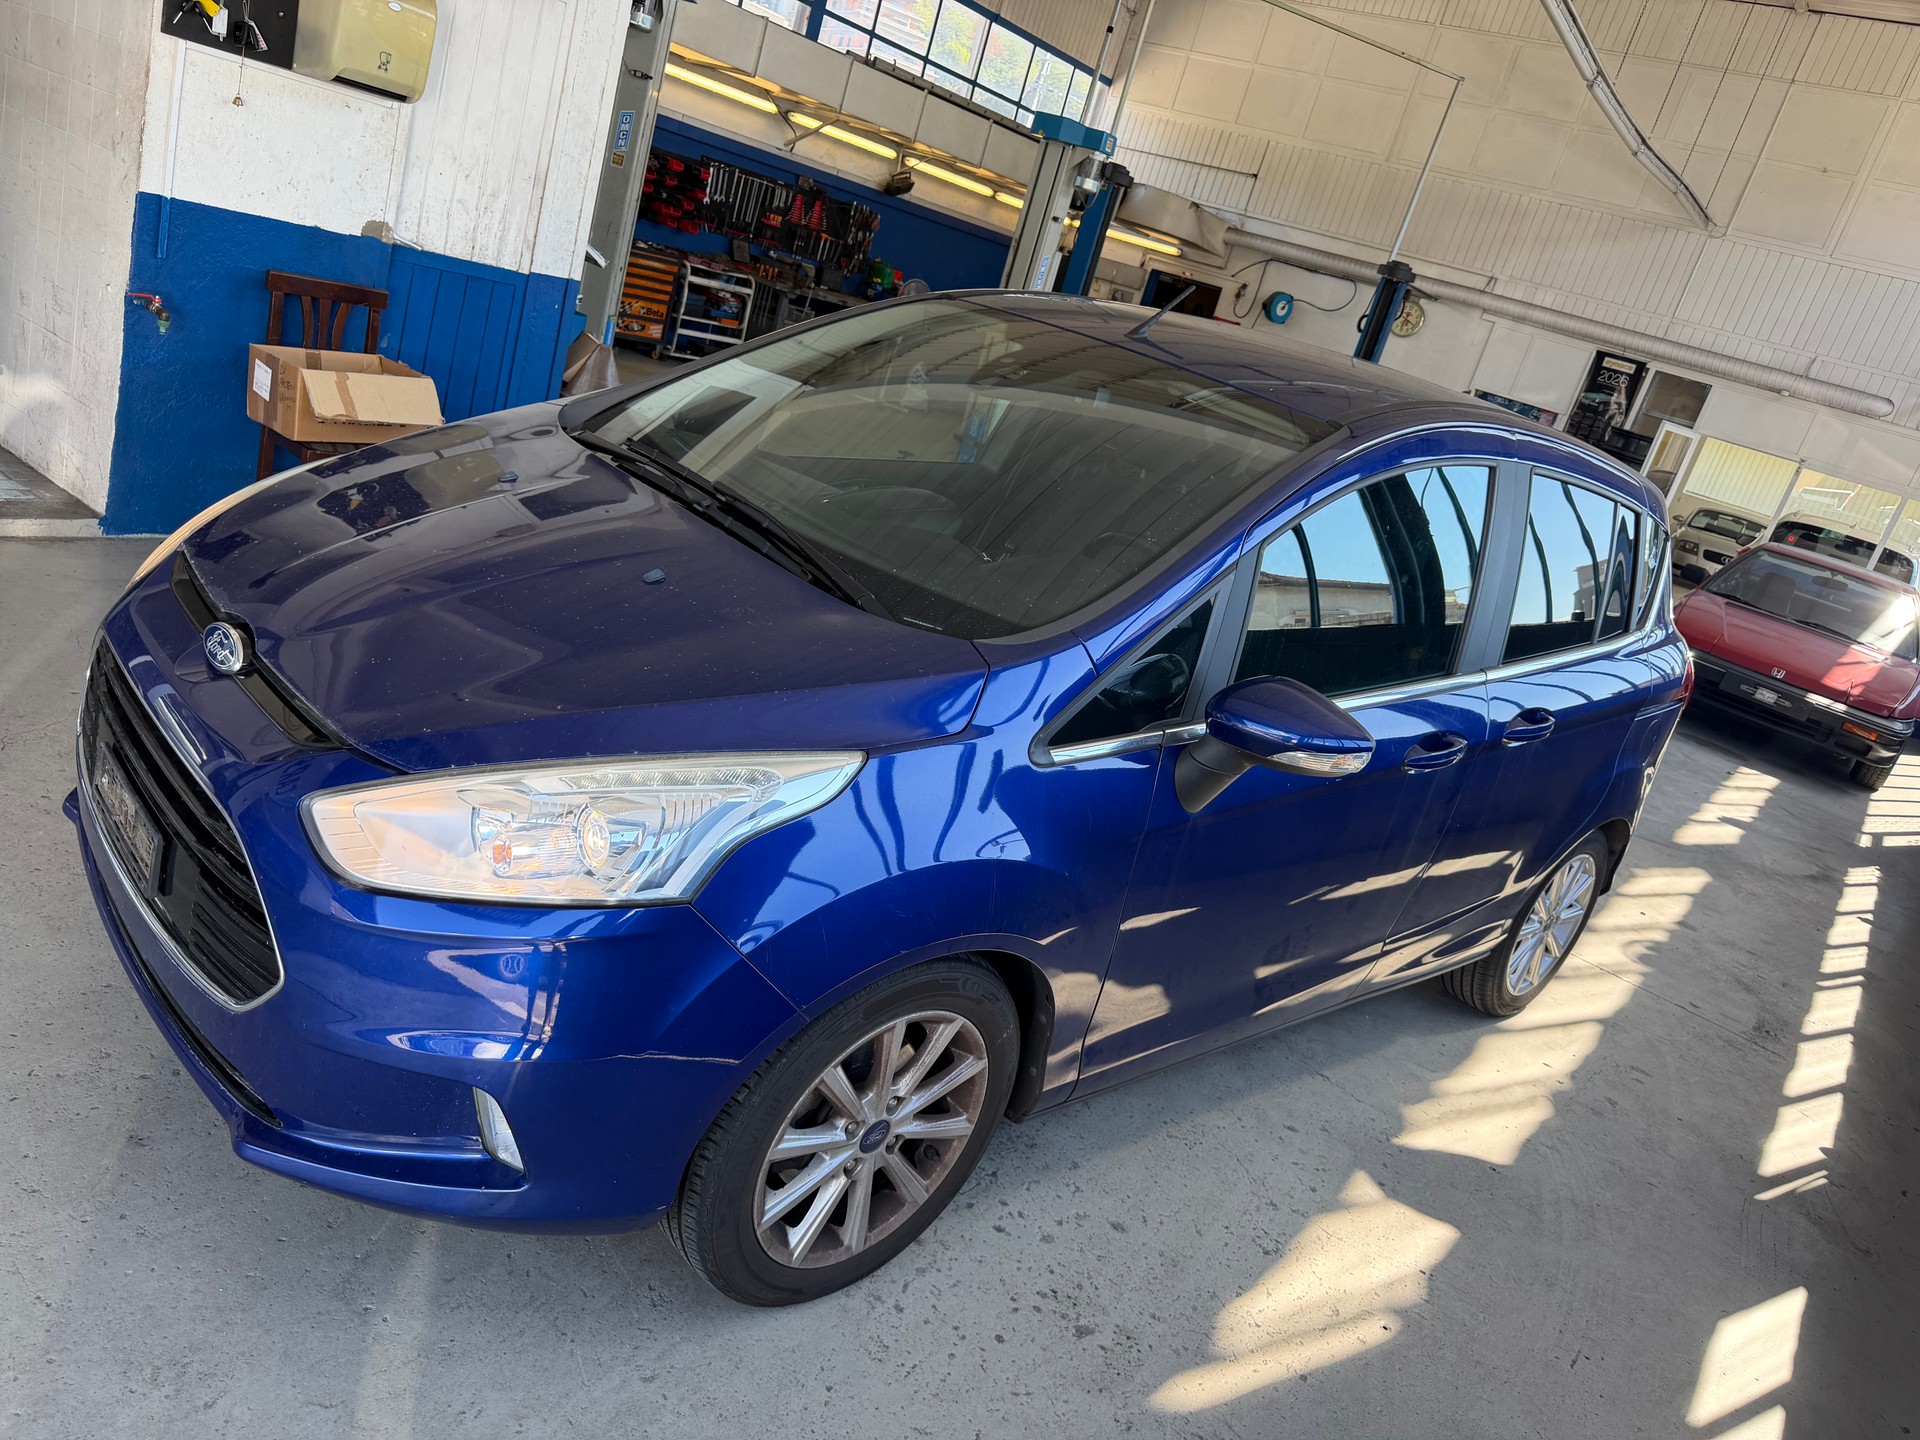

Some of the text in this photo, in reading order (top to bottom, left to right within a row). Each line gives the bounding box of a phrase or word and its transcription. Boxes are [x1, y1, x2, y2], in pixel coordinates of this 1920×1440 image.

[617, 115, 630, 147] OMCN
[646, 307, 664, 319] Beta
[1597, 370, 1630, 387] 2026
[206, 629, 231, 661] Ford
